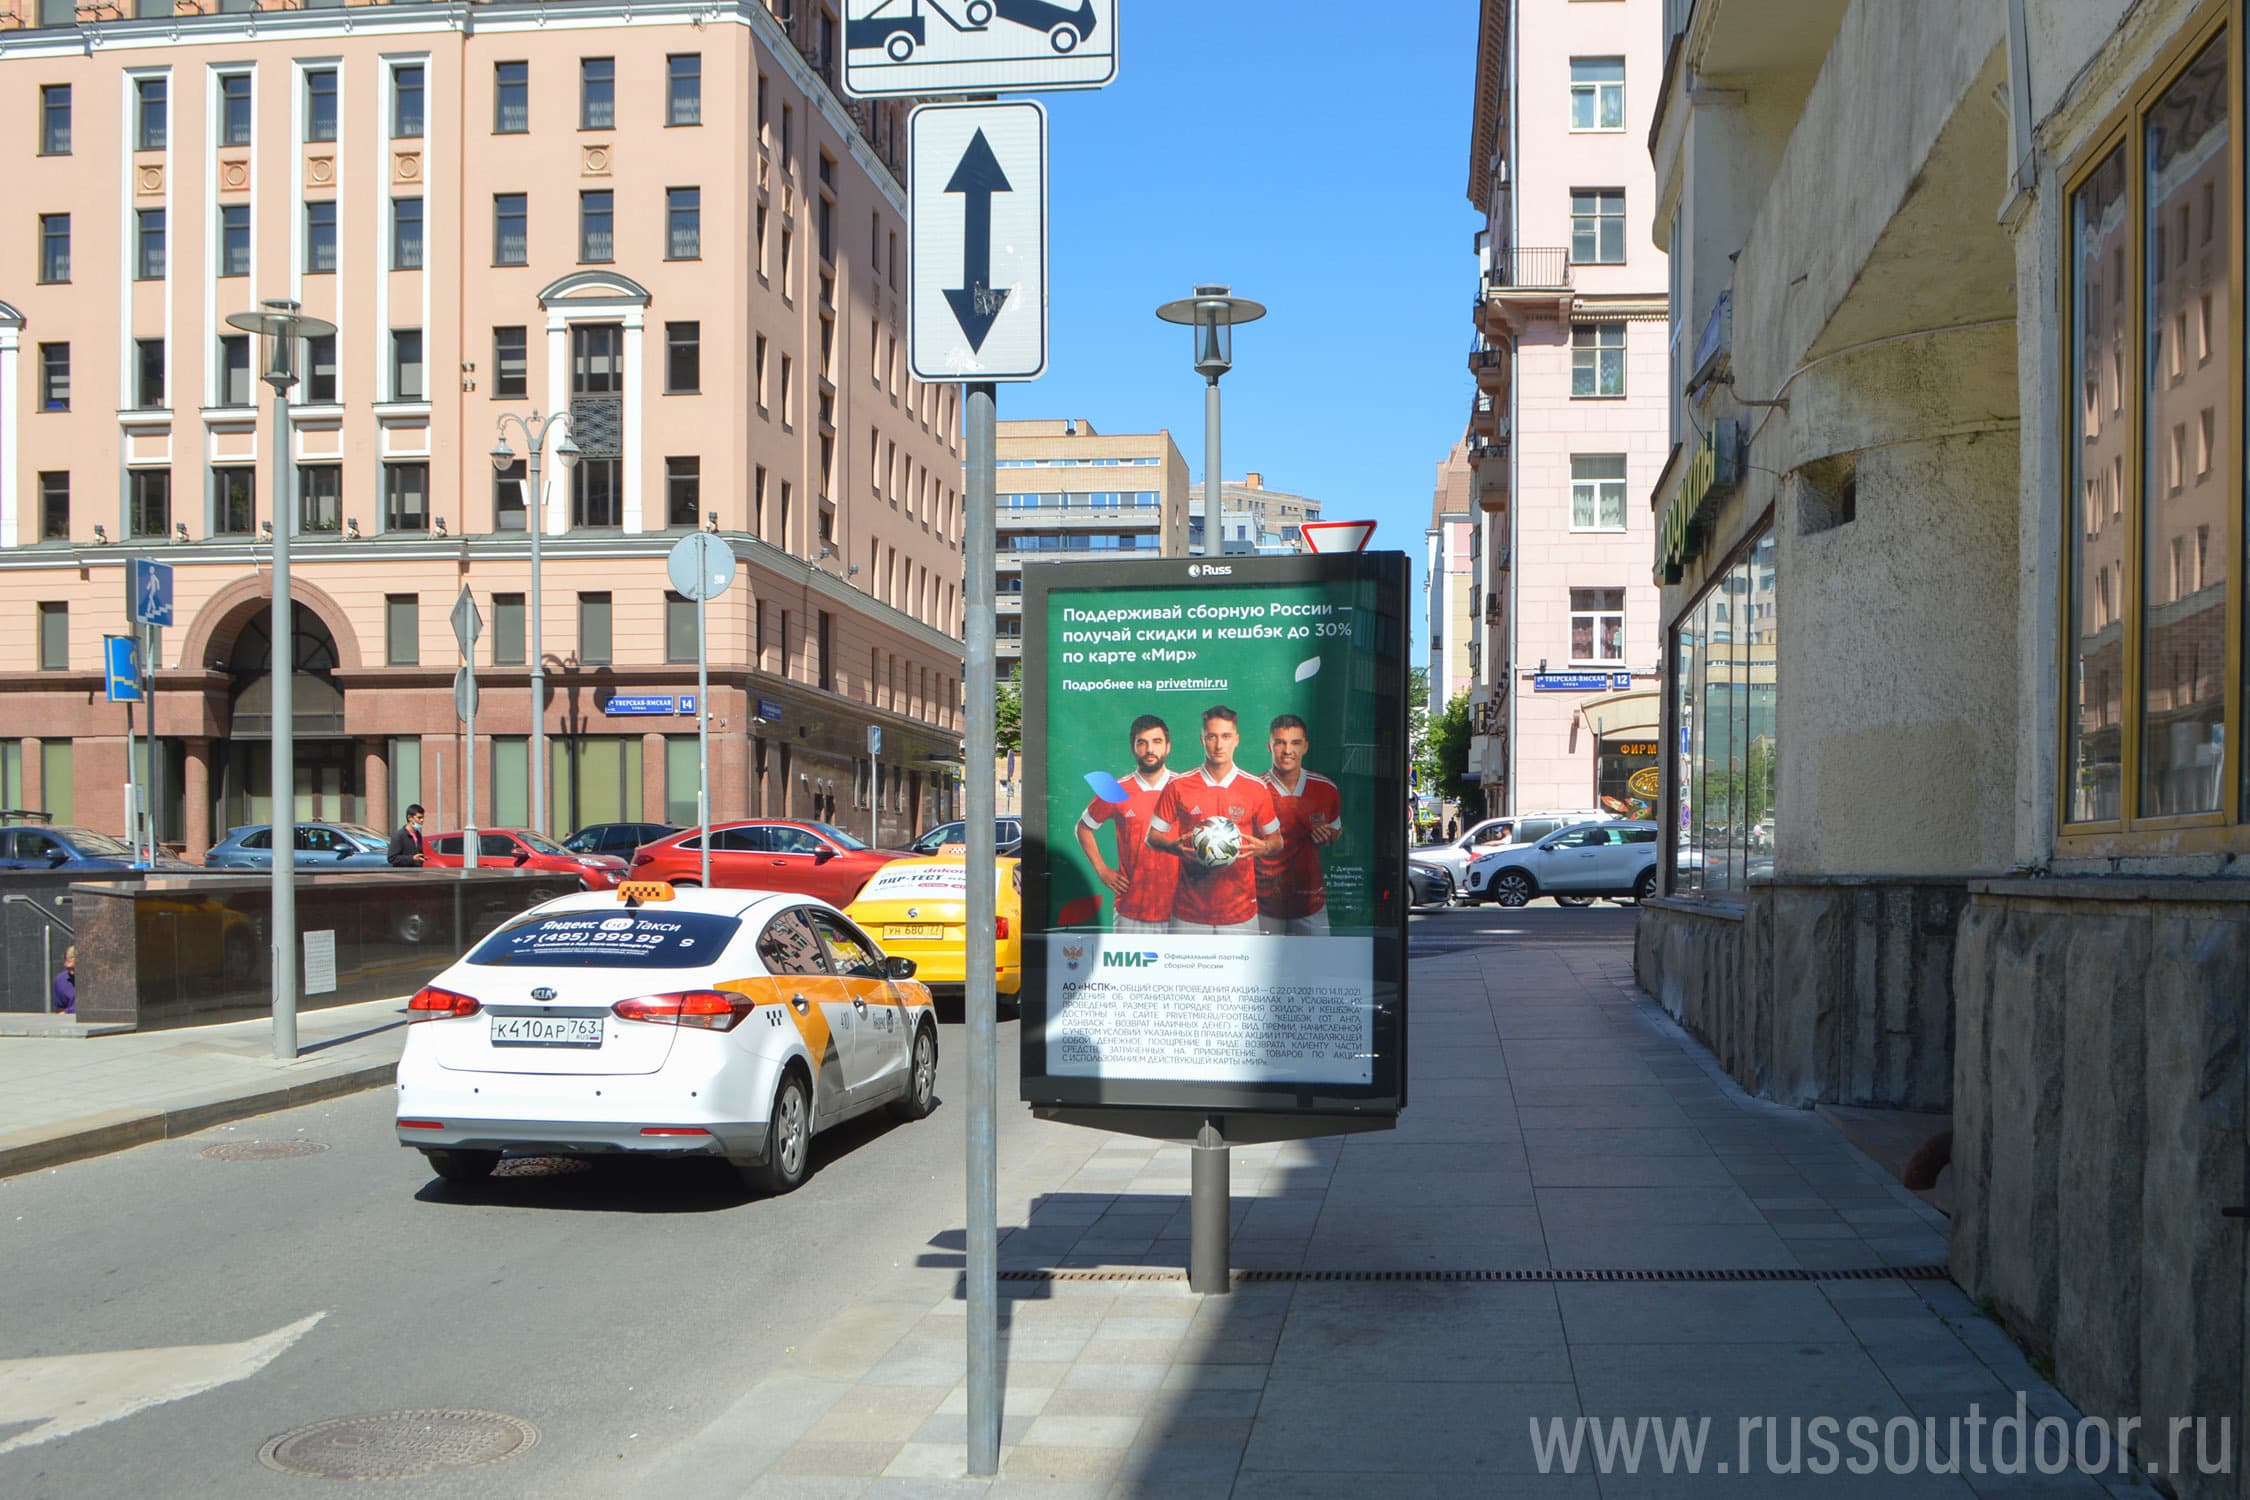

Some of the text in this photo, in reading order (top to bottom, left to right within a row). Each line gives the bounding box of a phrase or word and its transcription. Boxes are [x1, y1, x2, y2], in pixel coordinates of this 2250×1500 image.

[1202, 565, 1232, 576] Russ
[1063, 604, 1183, 624] Поддерживай
[1187, 603, 1265, 621] сборную
[1270, 602, 1333, 617] России
[1062, 622, 1353, 645] получай скидки и кешбэк до 30%
[1062, 647, 1197, 665] по карте «Мир»
[1062, 676, 1228, 692] Подробнее на privetmir.ru
[1616, 675, 1628, 684] 12
[682, 699, 693, 709] 14
[878, 874, 944, 886] ПЦР-ТЕСТ
[539, 920, 600, 931] Яндекс
[635, 919, 682, 932] Такси
[904, 925, 924, 935] 680
[512, 934, 536, 944] +7
[538, 932, 590, 944] (495)
[592, 932, 635, 942] 999
[635, 934, 665, 944] 99
[1103, 951, 1159, 967] МИР
[533, 989, 554, 999] KIA
[1062, 982, 1076, 991] АО
[1152, 985, 1174, 993] СРОК
[1175, 985, 1230, 994] ПРОВЕДЕНИЯ
[1315, 987, 1328, 995] ПО
[1062, 992, 1105, 1000] СВЕДЕНИЯ
[1129, 993, 1195, 1001] ОРГАНИЗАТОРАХ
[1238, 995, 1281, 1003] ПРАВИЛАХ
[1122, 1001, 1158, 1009] РАЗМЕРЕ
[1174, 1003, 1212, 1011] ПОРЯДКЕ
[1217, 1003, 1265, 1012] ПОЛУЧЕНИЯ
[1269, 1005, 1304, 1013] СКИДОК
[1062, 1010, 1107, 1018] ДОСТУПНЫ
[497, 1019, 598, 1039] К410АР 763
[1062, 1019, 1104, 1027] CASHBACK
[1115, 1019, 1149, 1027] ВОЗВРАТ
[1154, 1020, 1197, 1028] НАЛИЧНЫХ
[1241, 1021, 1259, 1031] ВИД
[1300, 1023, 1362, 1032] НАЧИСЛЕННОЙ
[1143, 1029, 1192, 1037] УКАЗАННЫХ
[1200, 1030, 1243, 1038] ПРАВИЛАХ
[1281, 1032, 1362, 1041] ПРЕДСТАВЛЯЮЩЕЙ
[1097, 1037, 1141, 1045] ДЕНЕЖНОЕ
[1148, 1038, 1200, 1046] ПООЩРЕНИЕ
[1216, 1039, 1239, 1048] ВИДЕ
[1245, 1040, 1286, 1049] ВОЗВРАТА
[1291, 1041, 1329, 1049] КЛИЕНТУ
[1334, 1042, 1362, 1050] ЧАСТИ
[1194, 1048, 1257, 1057] ПРИОБРЕТЕНИЕ
[1266, 1049, 1304, 1058] ТОВАРОВ
[1312, 1050, 1325, 1058] ПО
[1068, 1054, 1146, 1062] ИСПОЛЬЗОВАНИЕМ
[1147, 1055, 1212, 1064] ДЕЙСТВУЮЩЕЙ
[1213, 1057, 1240, 1065] КАРТЫ
